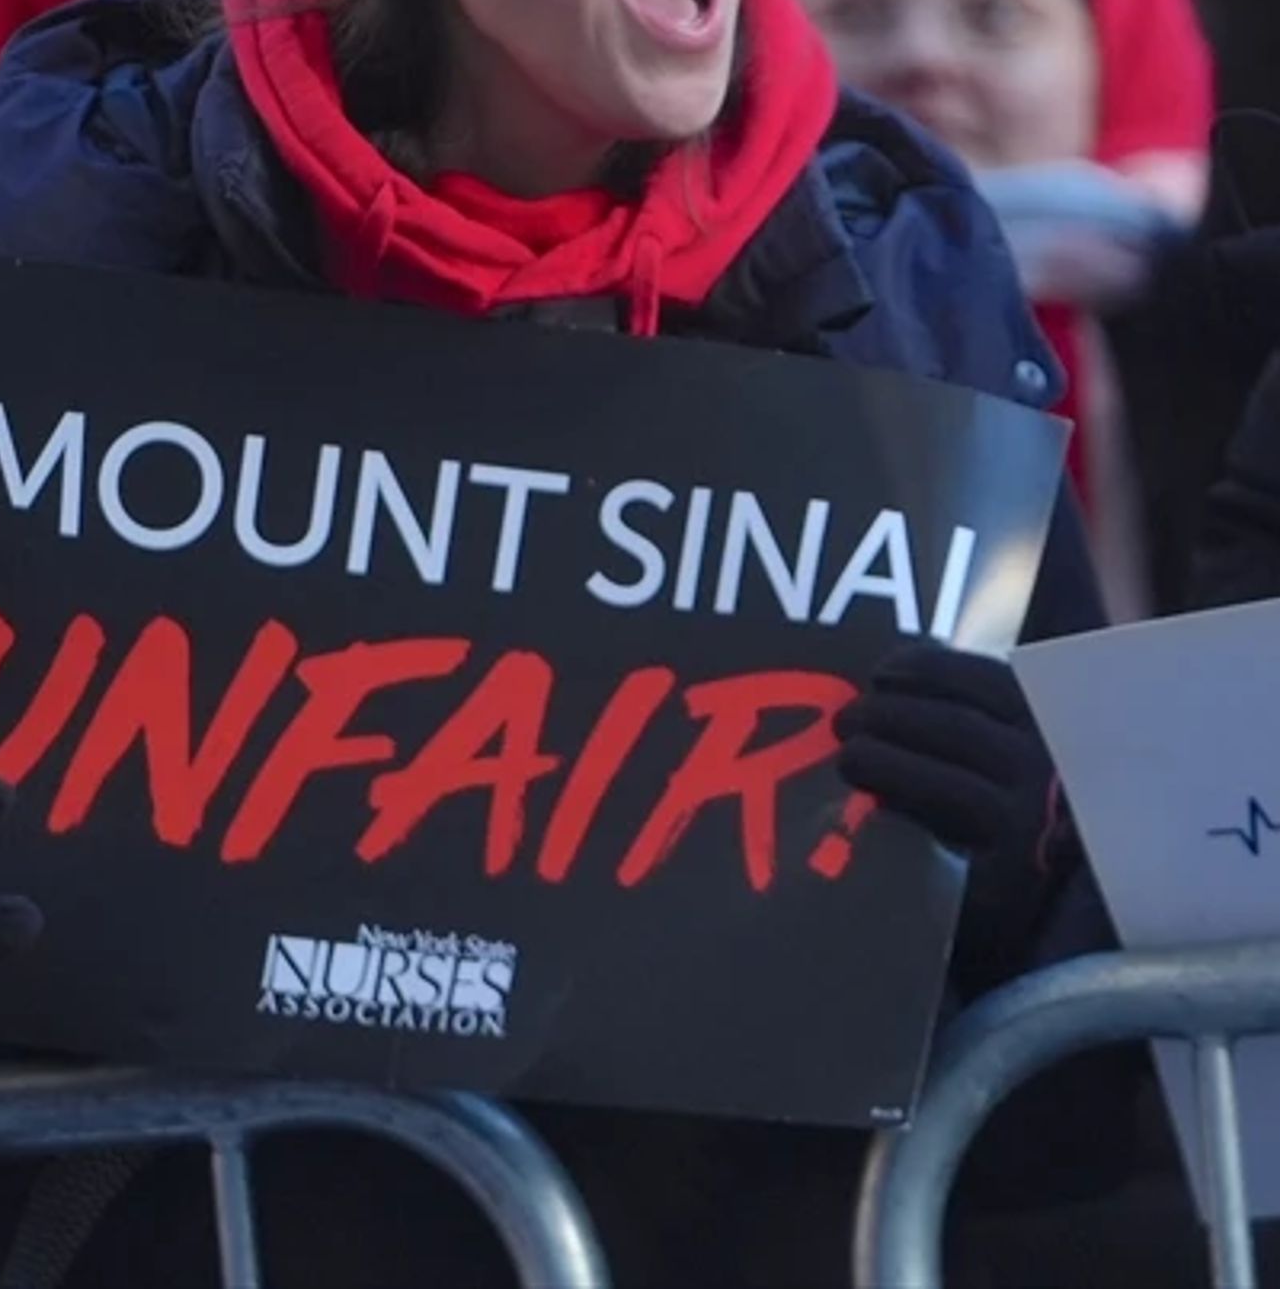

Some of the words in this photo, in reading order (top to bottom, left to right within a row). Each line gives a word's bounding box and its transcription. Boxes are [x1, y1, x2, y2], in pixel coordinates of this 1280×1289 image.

[586, 477, 979, 641] SINAI
[261, 933, 518, 1011] NURSES
[357, 923, 412, 950] New
[413, 927, 461, 956] York
[464, 933, 517, 961] State
[255, 989, 506, 1038] ASSOCIATION
